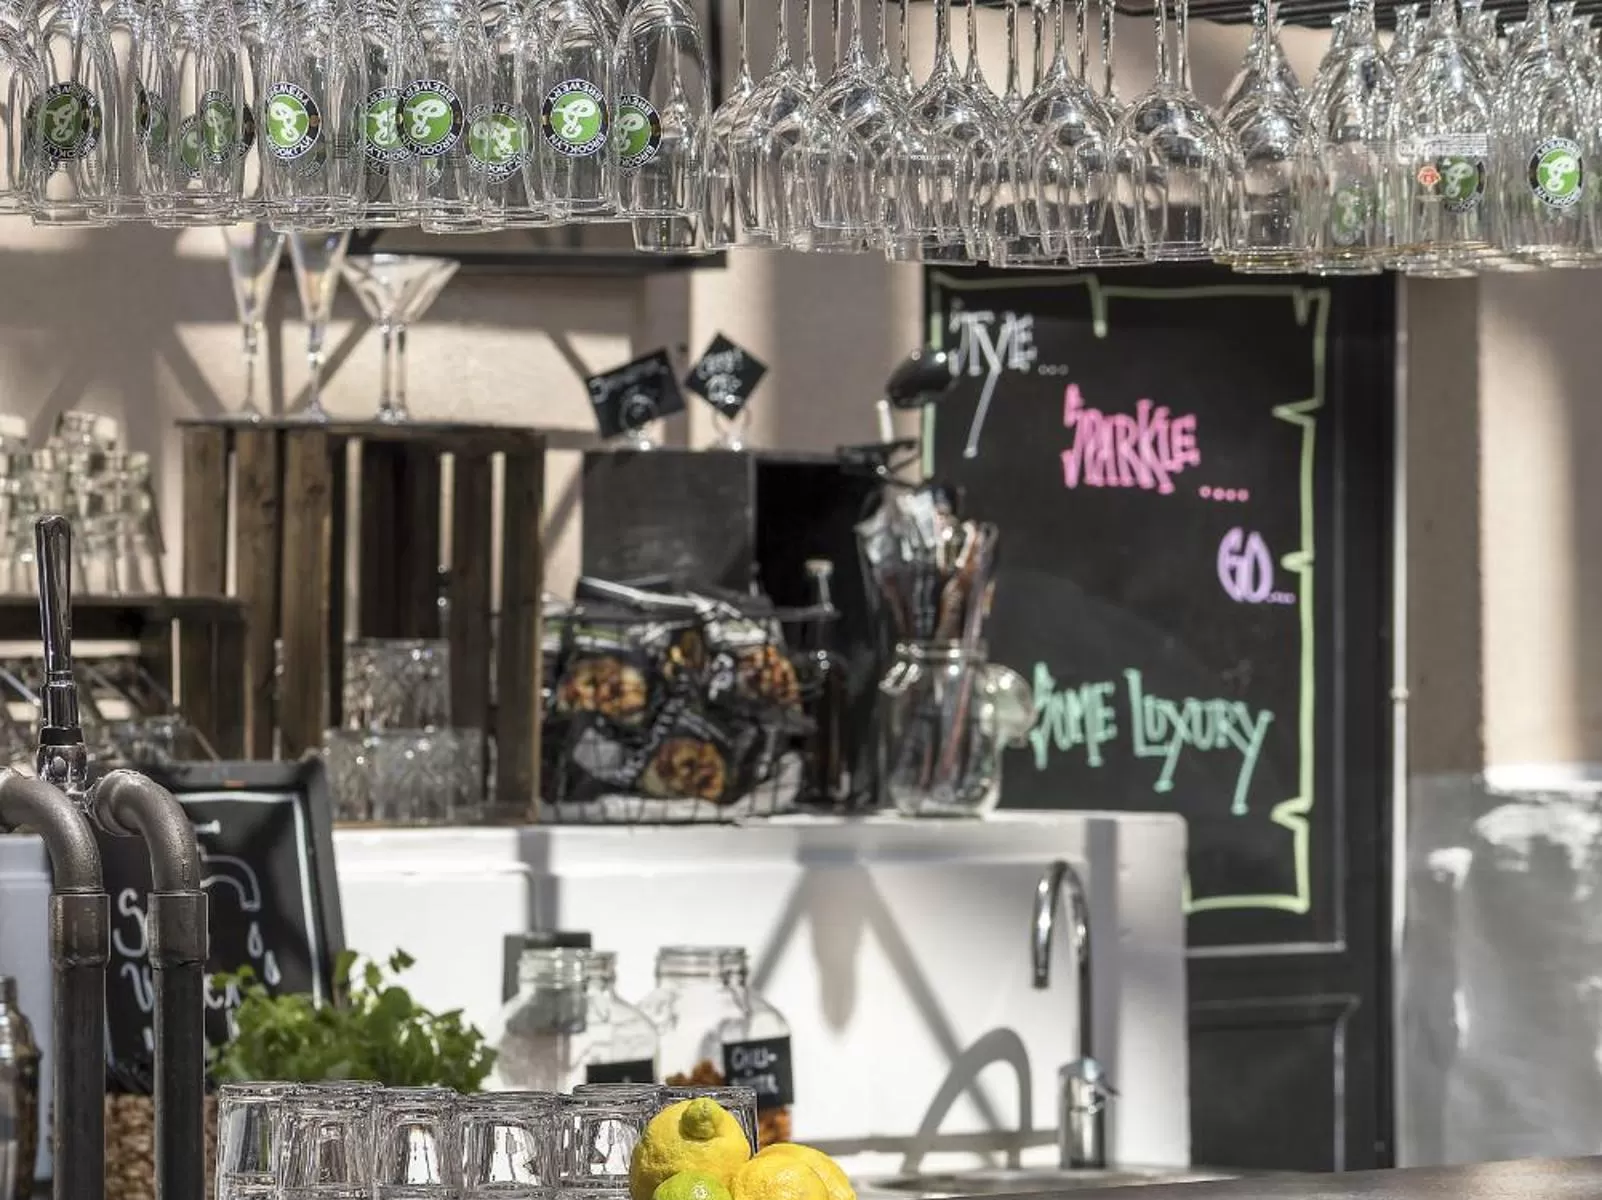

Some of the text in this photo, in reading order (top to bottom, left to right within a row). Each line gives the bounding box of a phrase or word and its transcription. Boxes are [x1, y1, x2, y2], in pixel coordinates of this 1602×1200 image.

[548, 80, 606, 103] BREWERY
[547, 132, 607, 155] BROOKLYN
[1123, 667, 1275, 816] LUXURY
